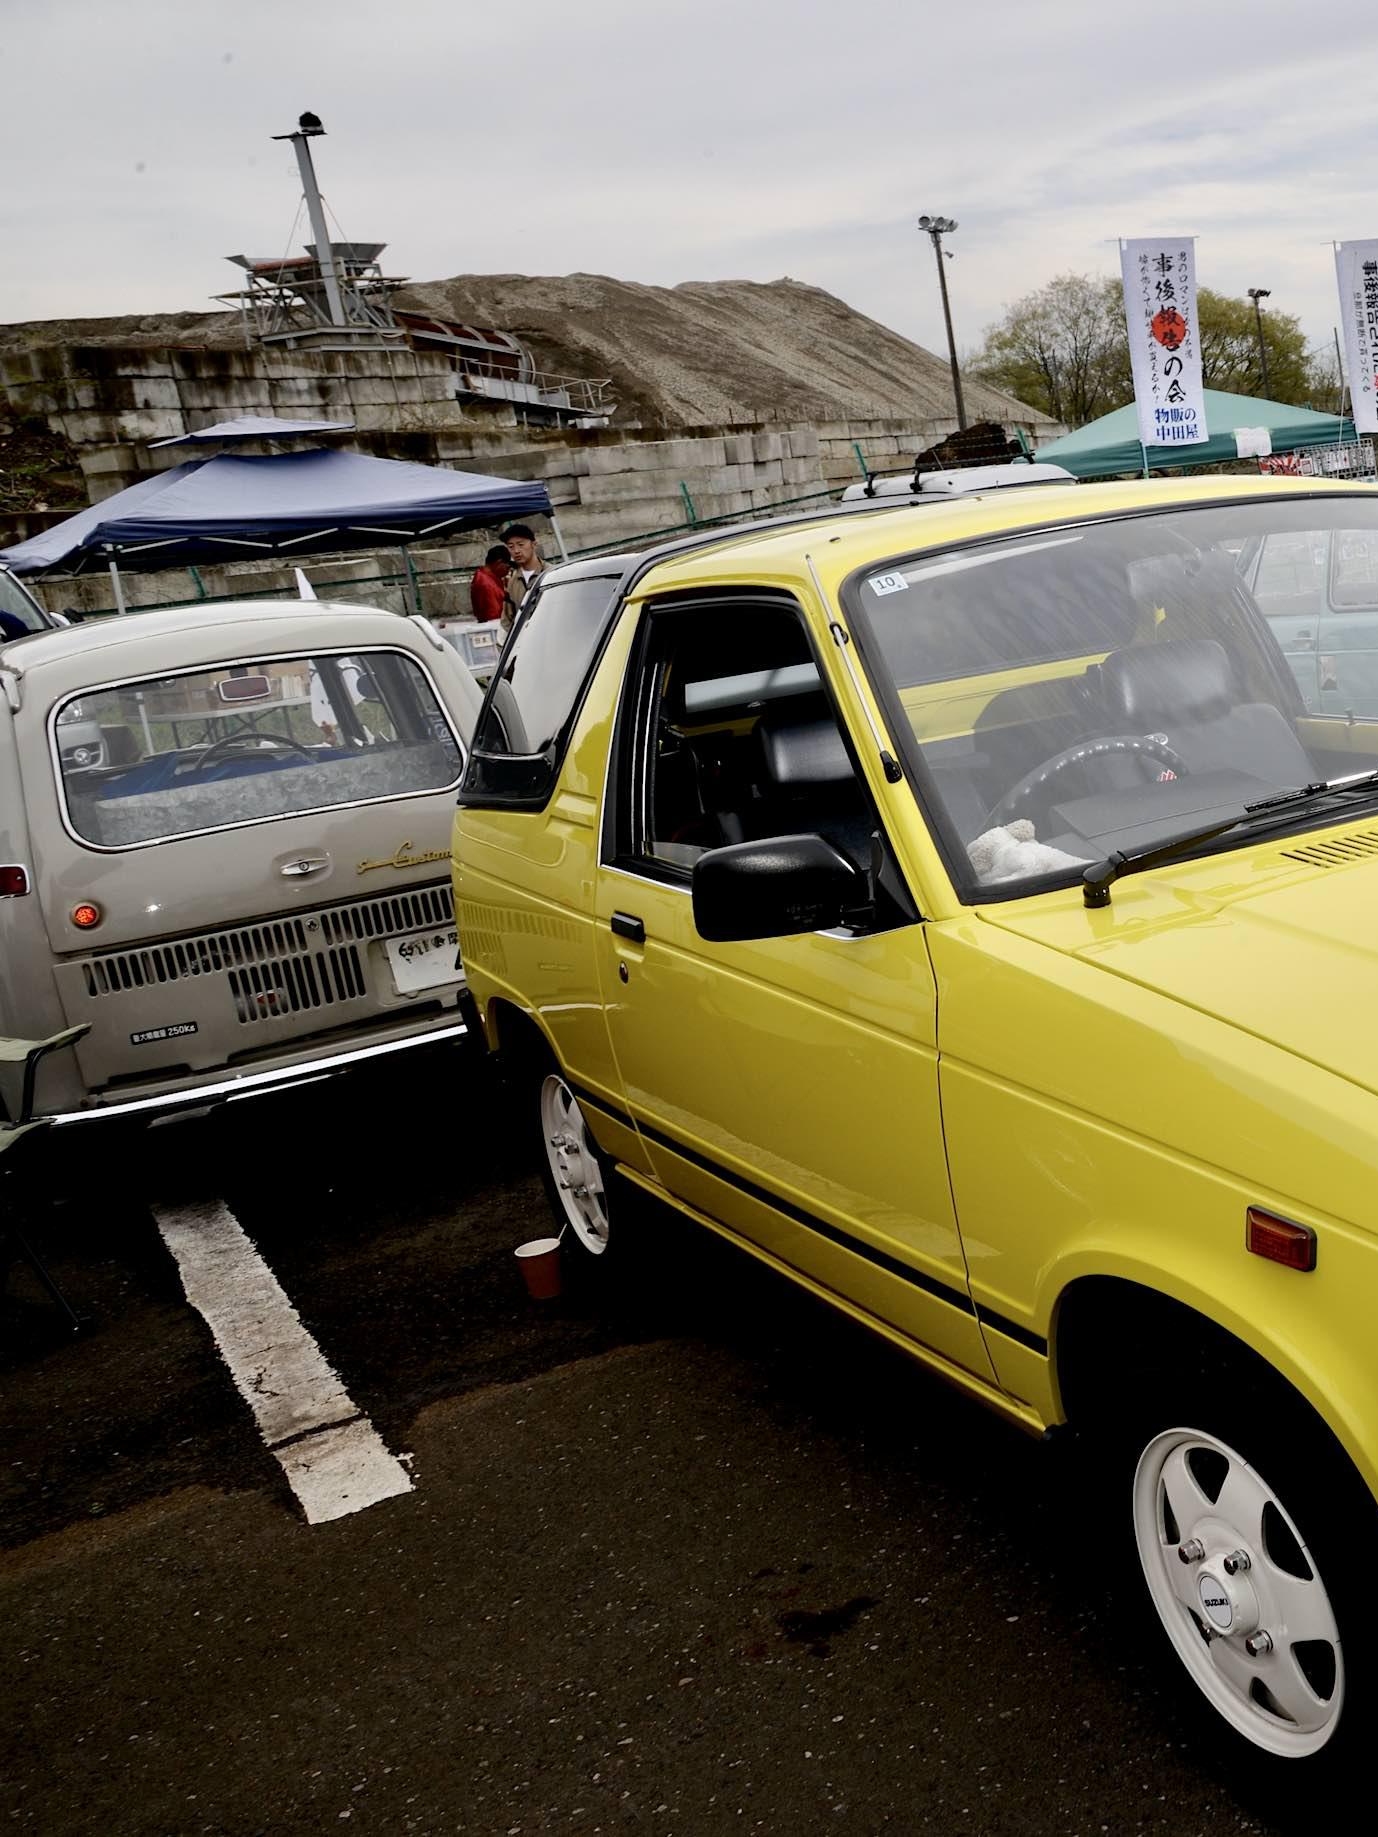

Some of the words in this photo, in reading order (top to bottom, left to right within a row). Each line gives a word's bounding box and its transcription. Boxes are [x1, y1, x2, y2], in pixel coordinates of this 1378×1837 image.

[1151, 252, 1187, 404] 事後報告の会
[1154, 407, 1196, 424] 物販の
[1156, 423, 1199, 441] 中田屋
[876, 576, 896, 590] 10
[1204, 1599, 1229, 1607] SUZUKI
